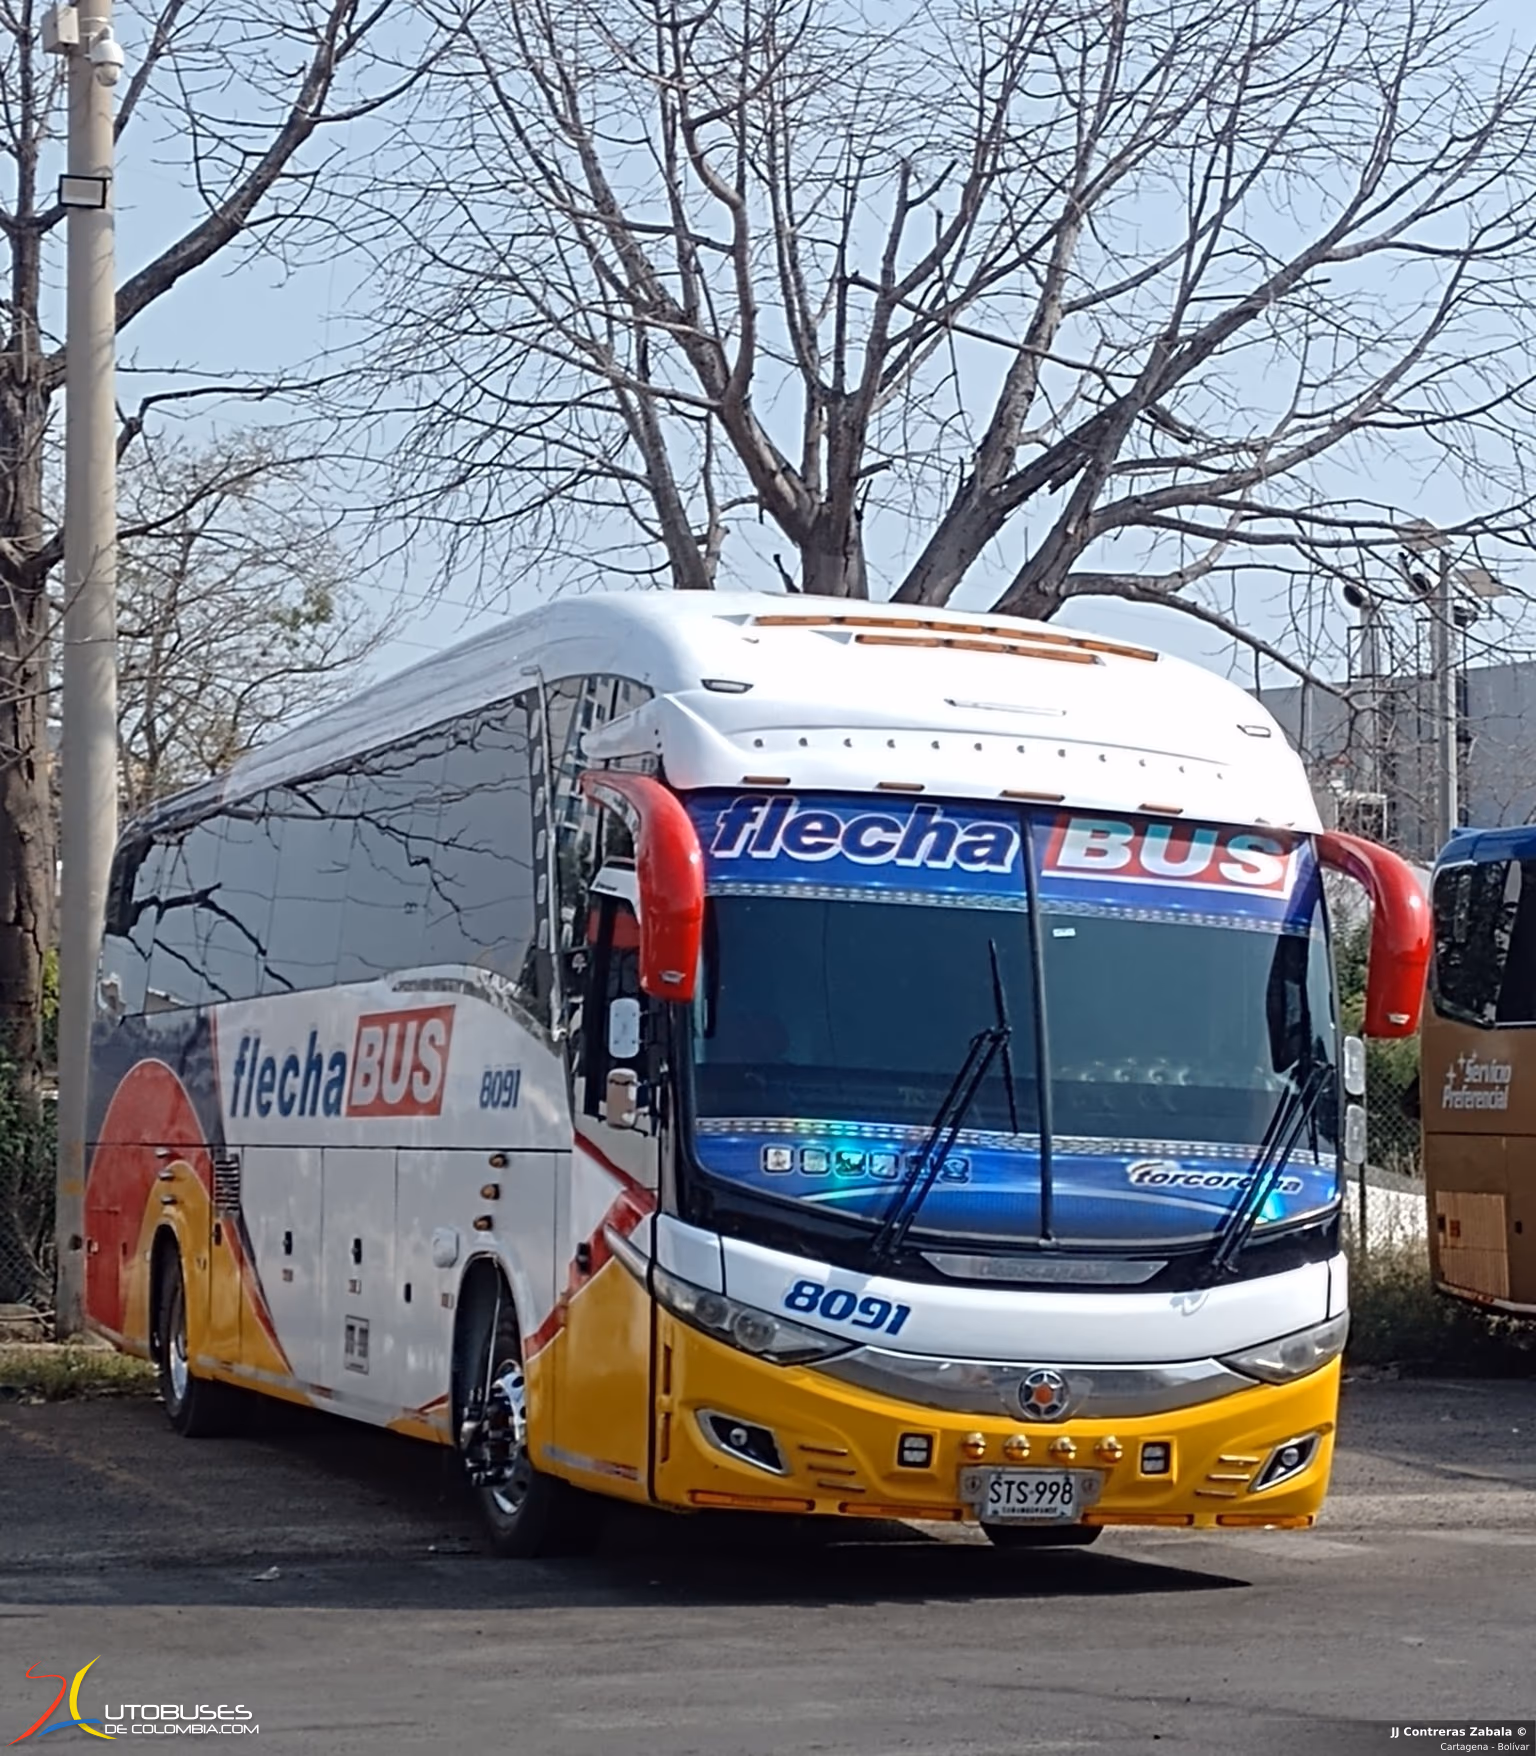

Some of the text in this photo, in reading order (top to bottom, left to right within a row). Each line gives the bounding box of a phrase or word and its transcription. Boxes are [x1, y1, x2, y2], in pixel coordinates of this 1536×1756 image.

[711, 795, 1286, 886] flecha BUS
[229, 1017, 446, 1118] flecha BUS
[479, 1068, 521, 1110] 8091
[784, 1279, 912, 1336] 8091
